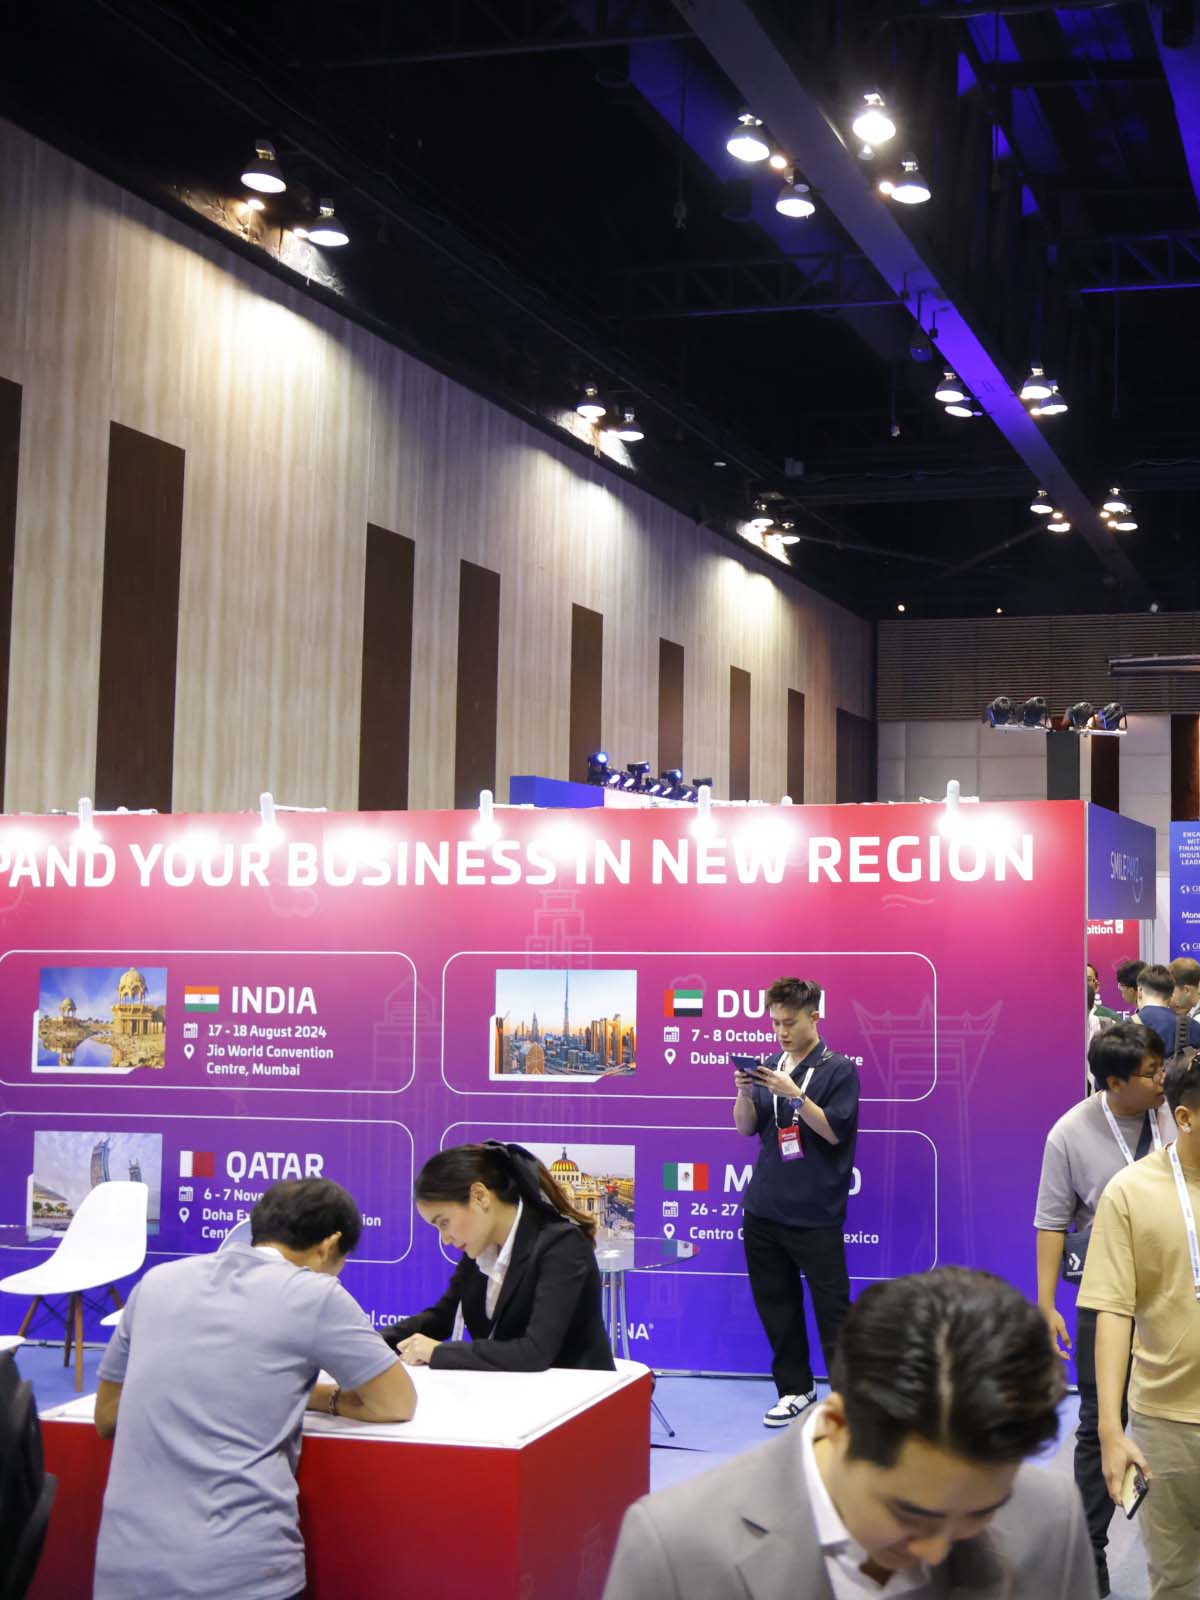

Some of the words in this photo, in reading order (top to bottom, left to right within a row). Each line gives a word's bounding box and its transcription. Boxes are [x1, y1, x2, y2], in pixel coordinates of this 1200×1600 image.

[129, 843, 268, 888] YOUR
[287, 841, 557, 887] BUSINESS
[575, 839, 631, 884] IN
[651, 839, 789, 884] NEW
[808, 835, 1034, 882] REGION
[231, 986, 317, 1014] INDIA
[717, 988, 826, 1019] DUI
[208, 1024, 222, 1037] 17
[233, 1025, 247, 1037] 18
[250, 1025, 292, 1040] August
[295, 1026, 327, 1038] 2024
[691, 1029, 700, 1042] 7
[713, 1030, 722, 1042] 8
[207, 1044, 225, 1057] Jio
[228, 1045, 263, 1057] World
[266, 1045, 334, 1059] Convention
[690, 1052, 729, 1065] Dubai
[206, 1062, 249, 1076] Centre,
[252, 1063, 300, 1076] Mumbai
[226, 1150, 324, 1183] QATAR
[203, 1189, 212, 1200] 6
[223, 1189, 231, 1201] 7
[202, 1208, 233, 1221] Doha
[690, 1203, 708, 1216] 26
[721, 1203, 738, 1216] 27
[689, 1226, 734, 1240] Centro
[843, 1231, 879, 1244] exico
